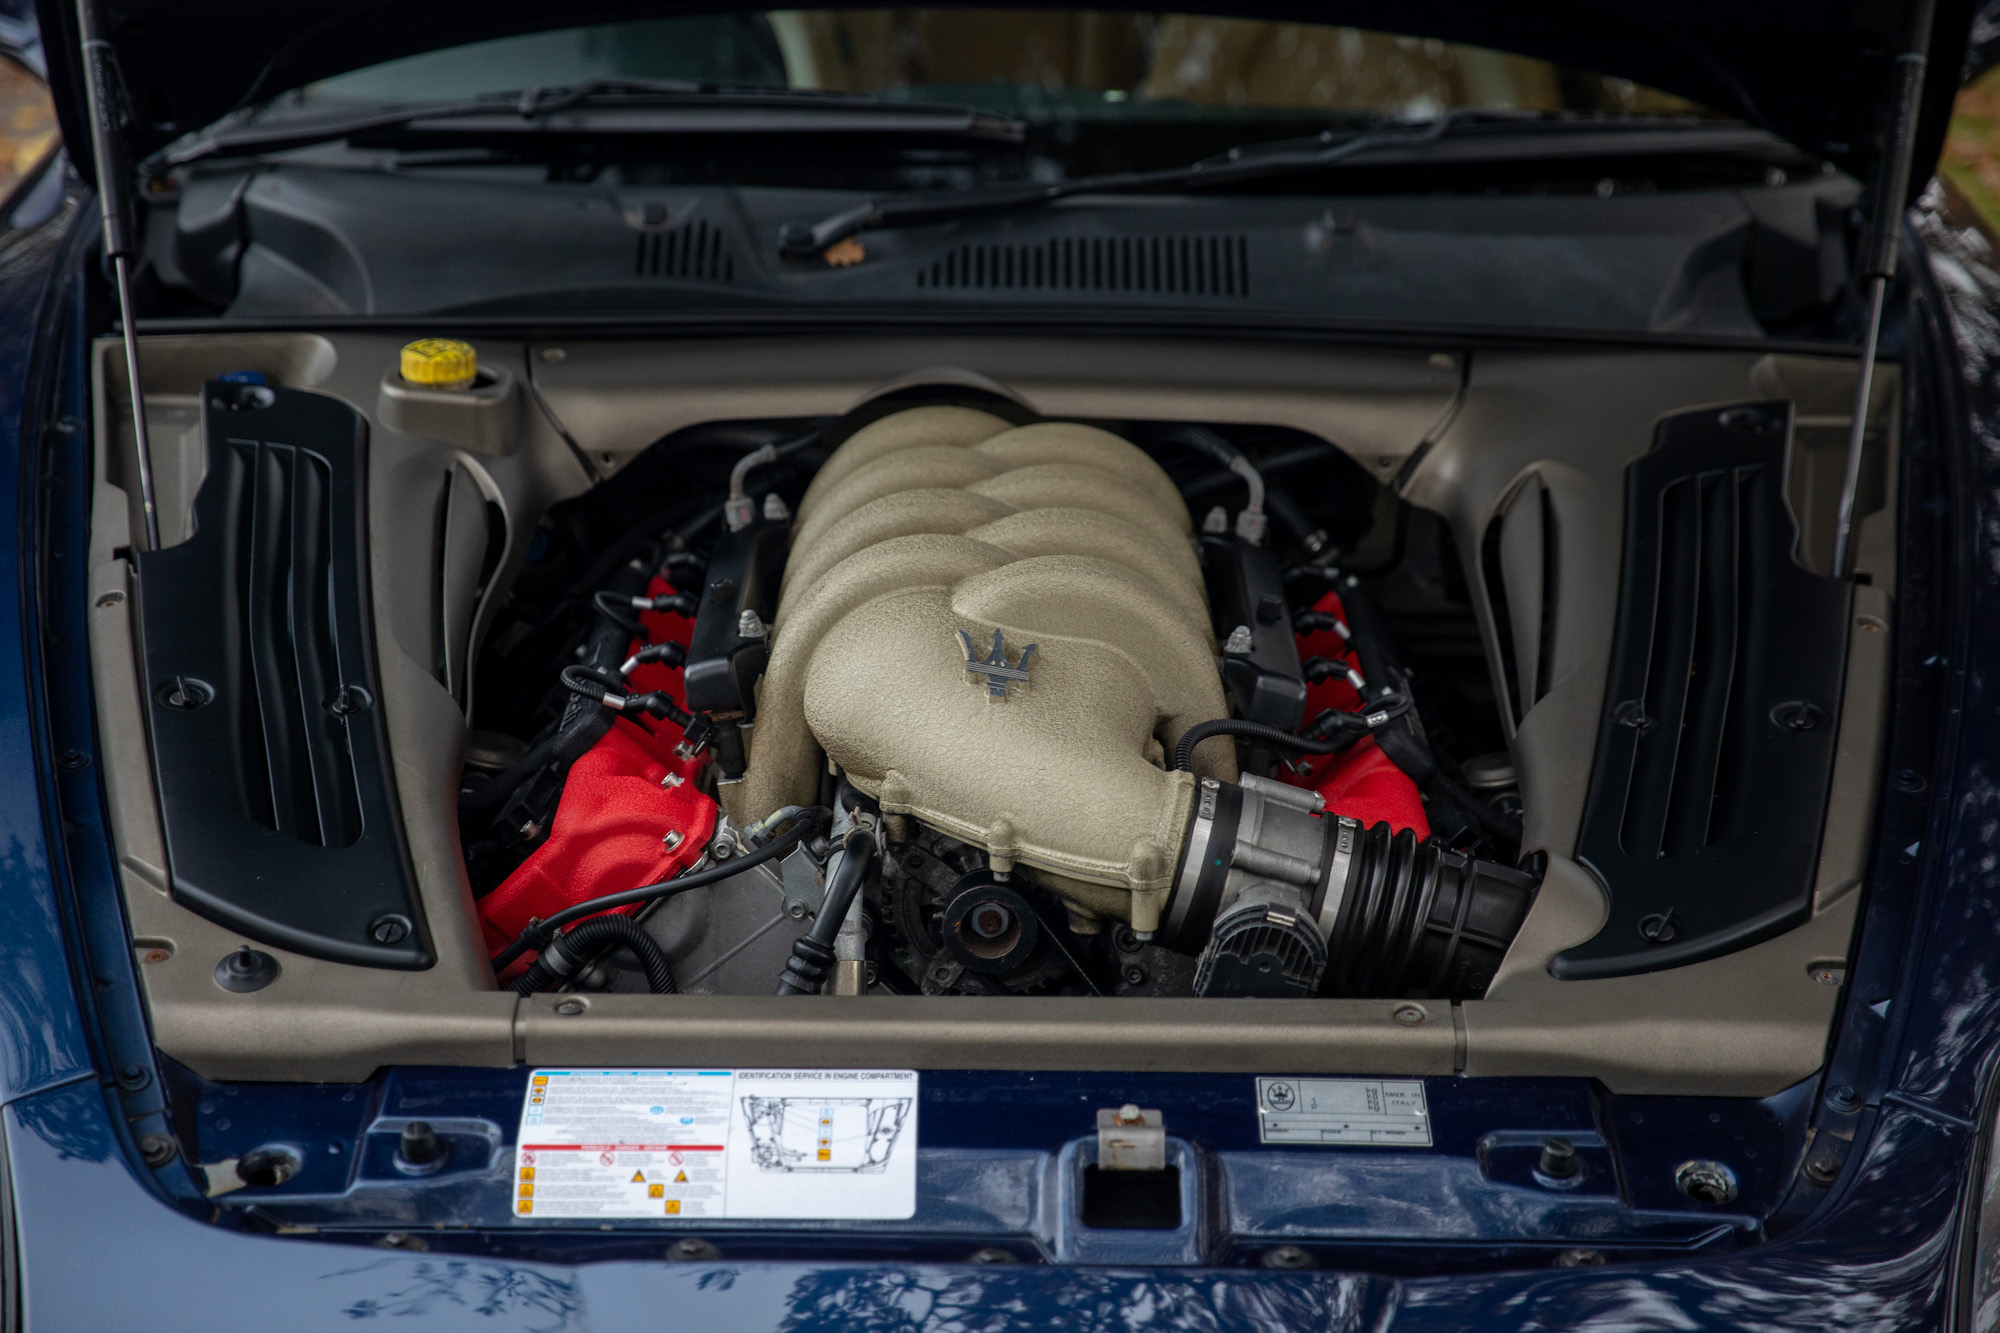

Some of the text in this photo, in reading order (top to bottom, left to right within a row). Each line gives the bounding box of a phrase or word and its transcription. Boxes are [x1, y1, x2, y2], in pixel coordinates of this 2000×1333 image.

[738, 1072, 913, 1080] IDENTIFICATION SERVICE IN ENGINE COMPARTMENT
